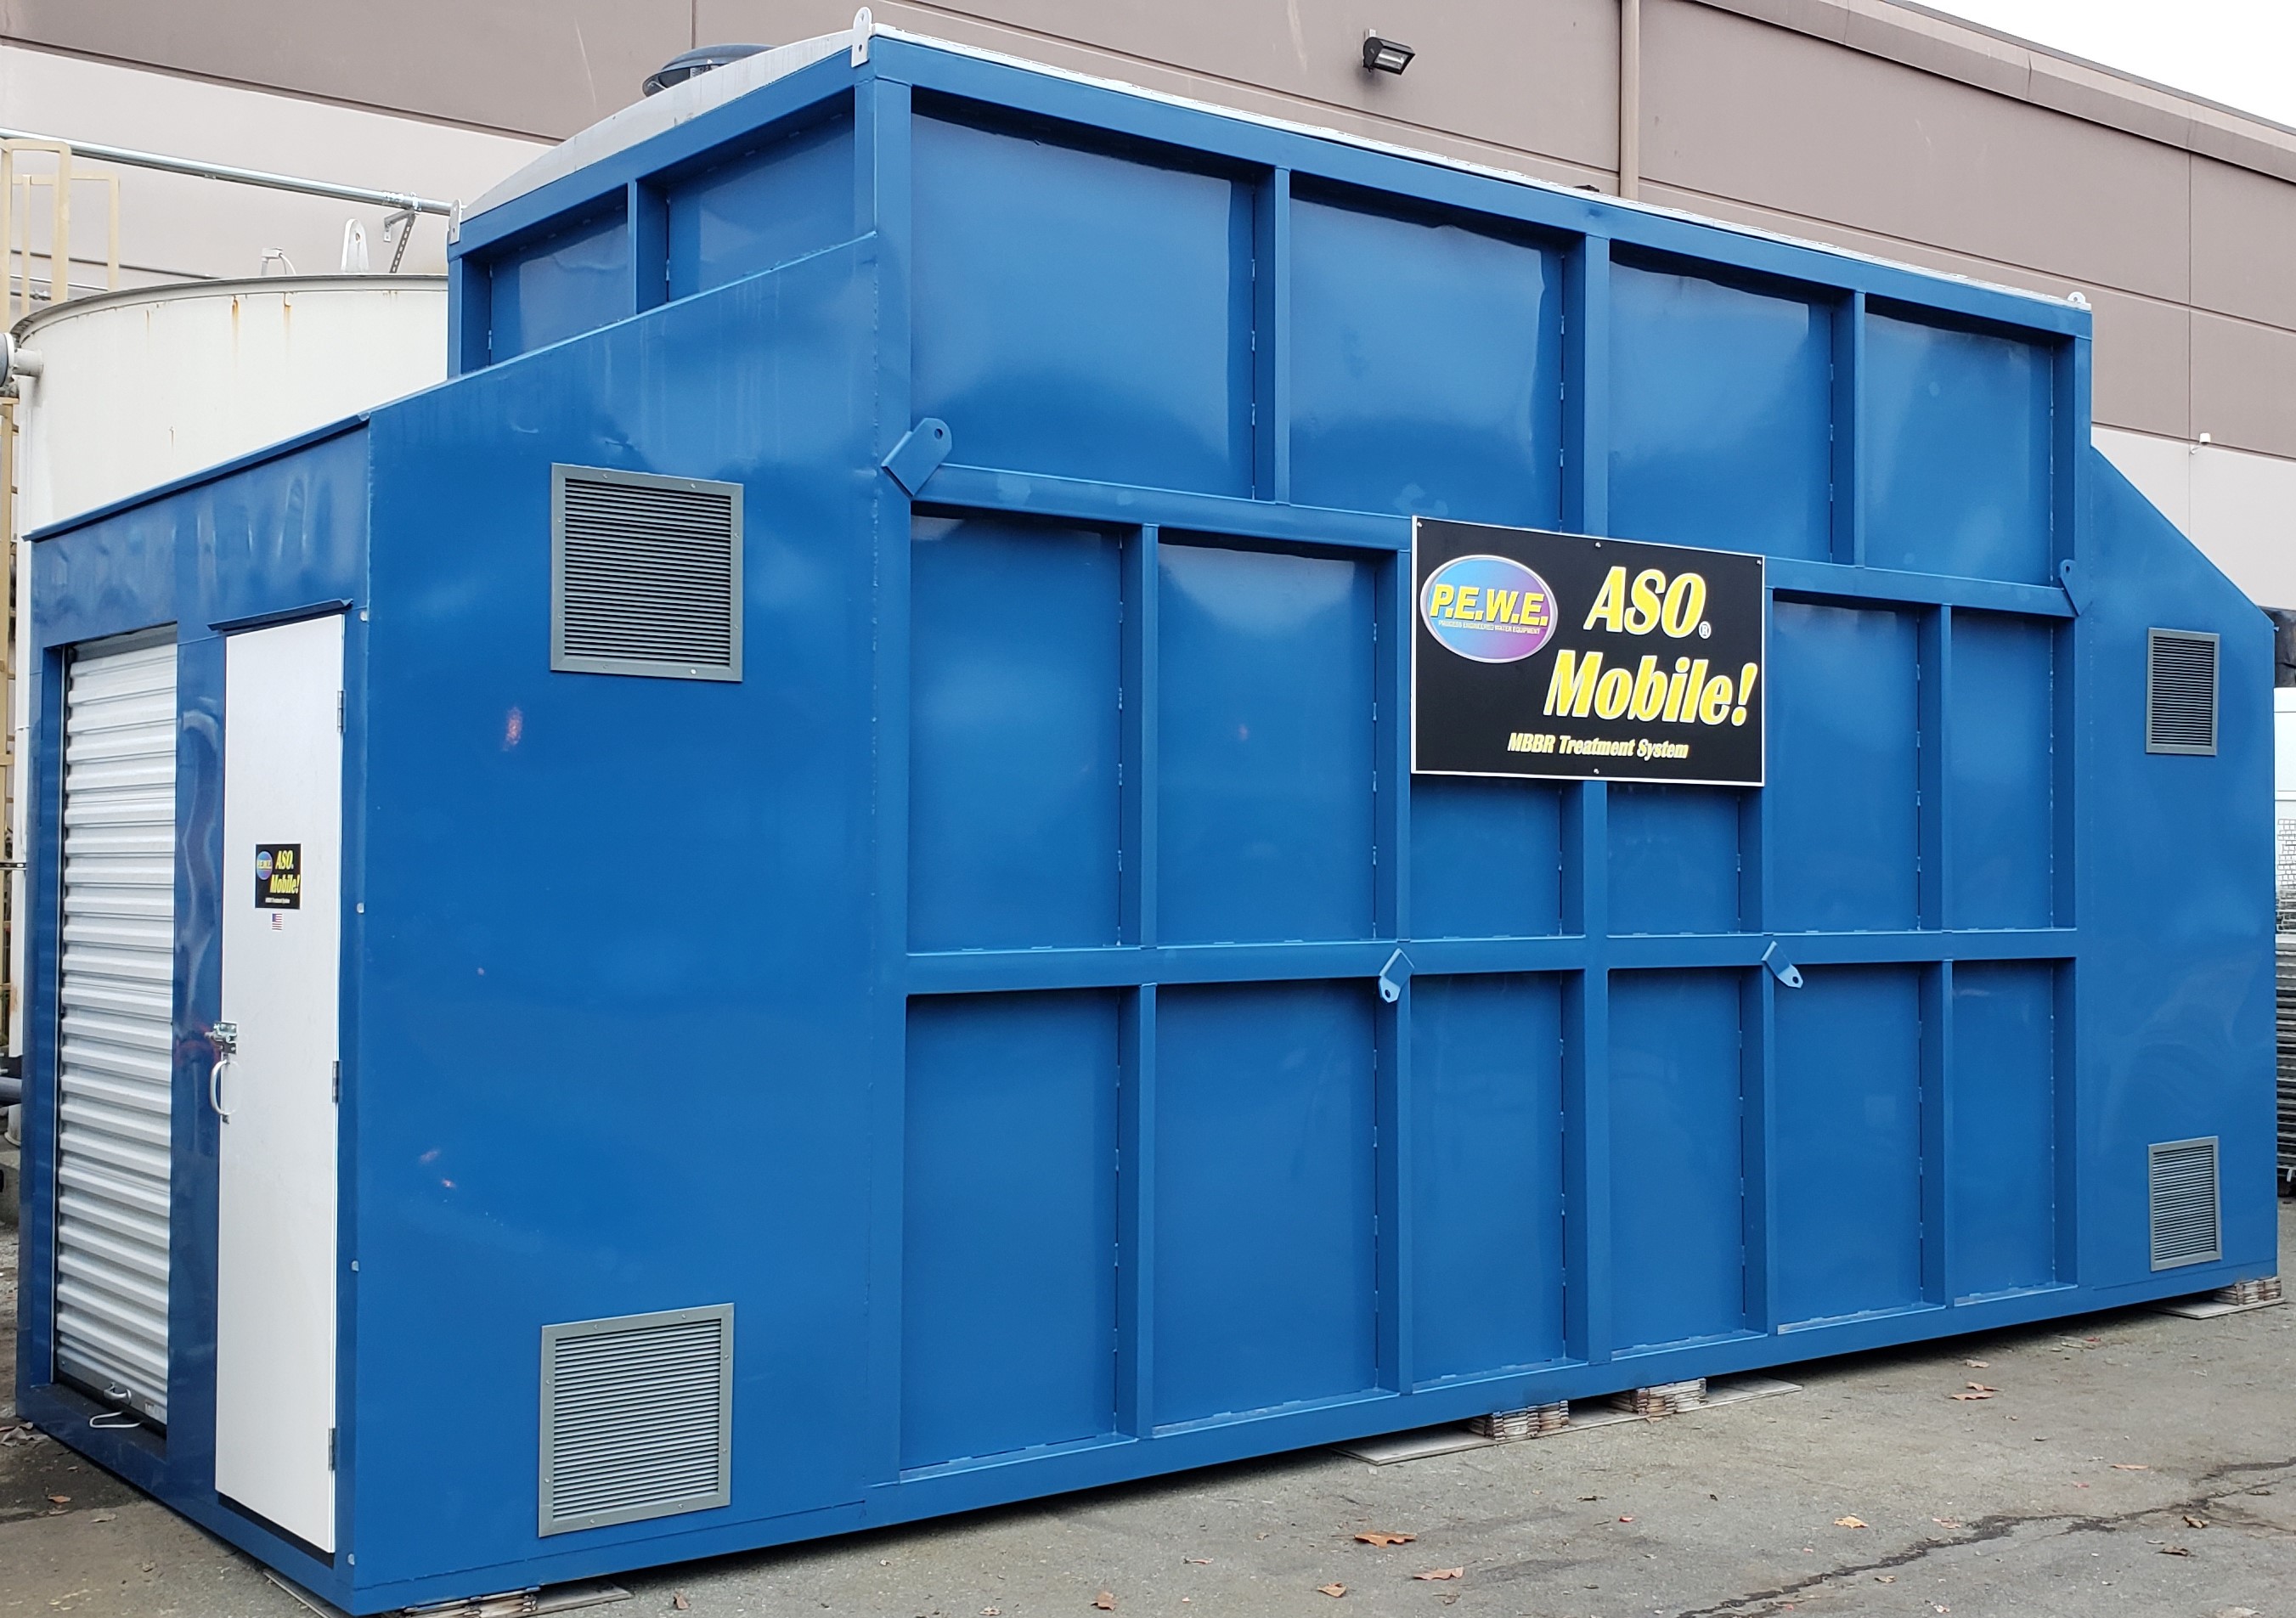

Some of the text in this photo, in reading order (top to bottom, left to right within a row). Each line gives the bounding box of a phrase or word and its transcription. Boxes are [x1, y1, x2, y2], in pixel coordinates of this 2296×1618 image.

[1430, 583, 1549, 627] P.E.W.E.
[1543, 649, 1758, 726] Mobile!
[1508, 732, 1690, 761] MBBR Treatment System
[269, 874, 301, 894] Mobile!
